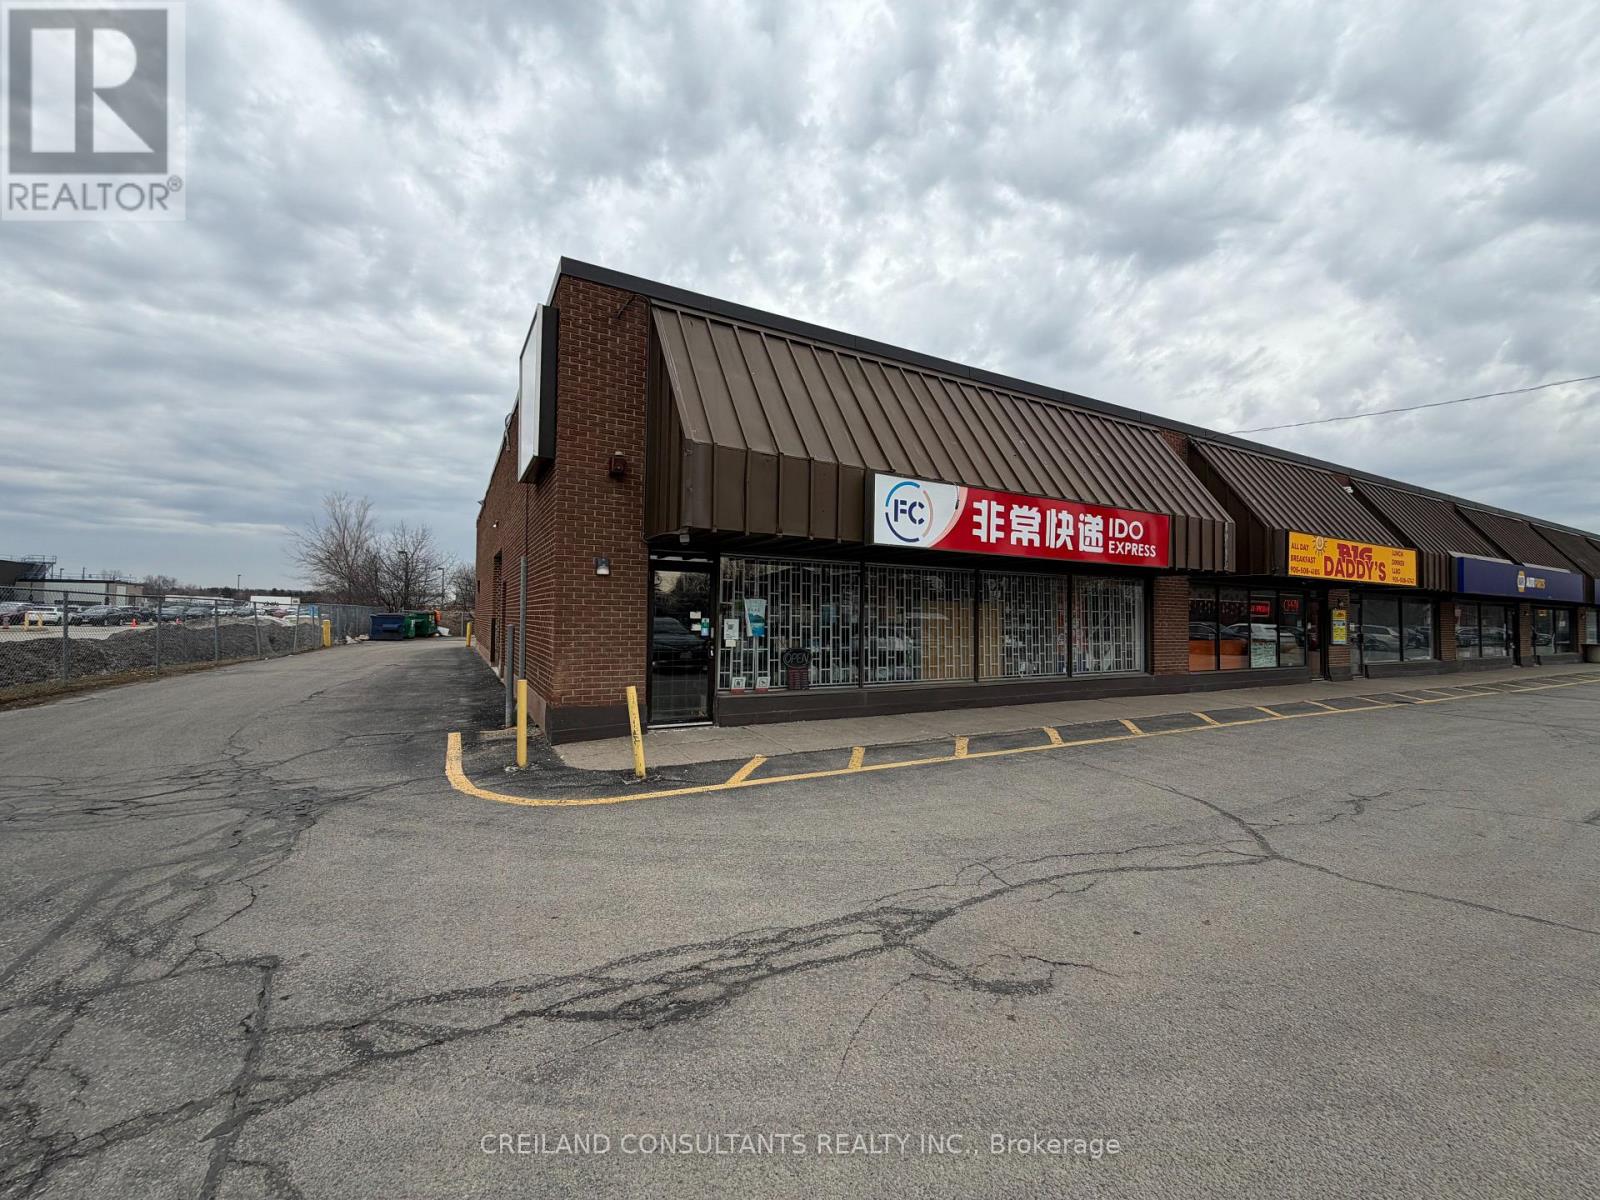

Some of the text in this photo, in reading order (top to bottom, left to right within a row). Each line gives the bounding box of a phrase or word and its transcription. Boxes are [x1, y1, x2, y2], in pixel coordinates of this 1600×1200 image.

[971, 498, 1105, 554] 非常快递
[1108, 517, 1144, 541] IDO
[1108, 541, 1157, 558] EXPRESS
[1337, 543, 1373, 564] BIG
[1323, 555, 1387, 582] DADDY'S
[785, 652, 810, 665] OPEN
